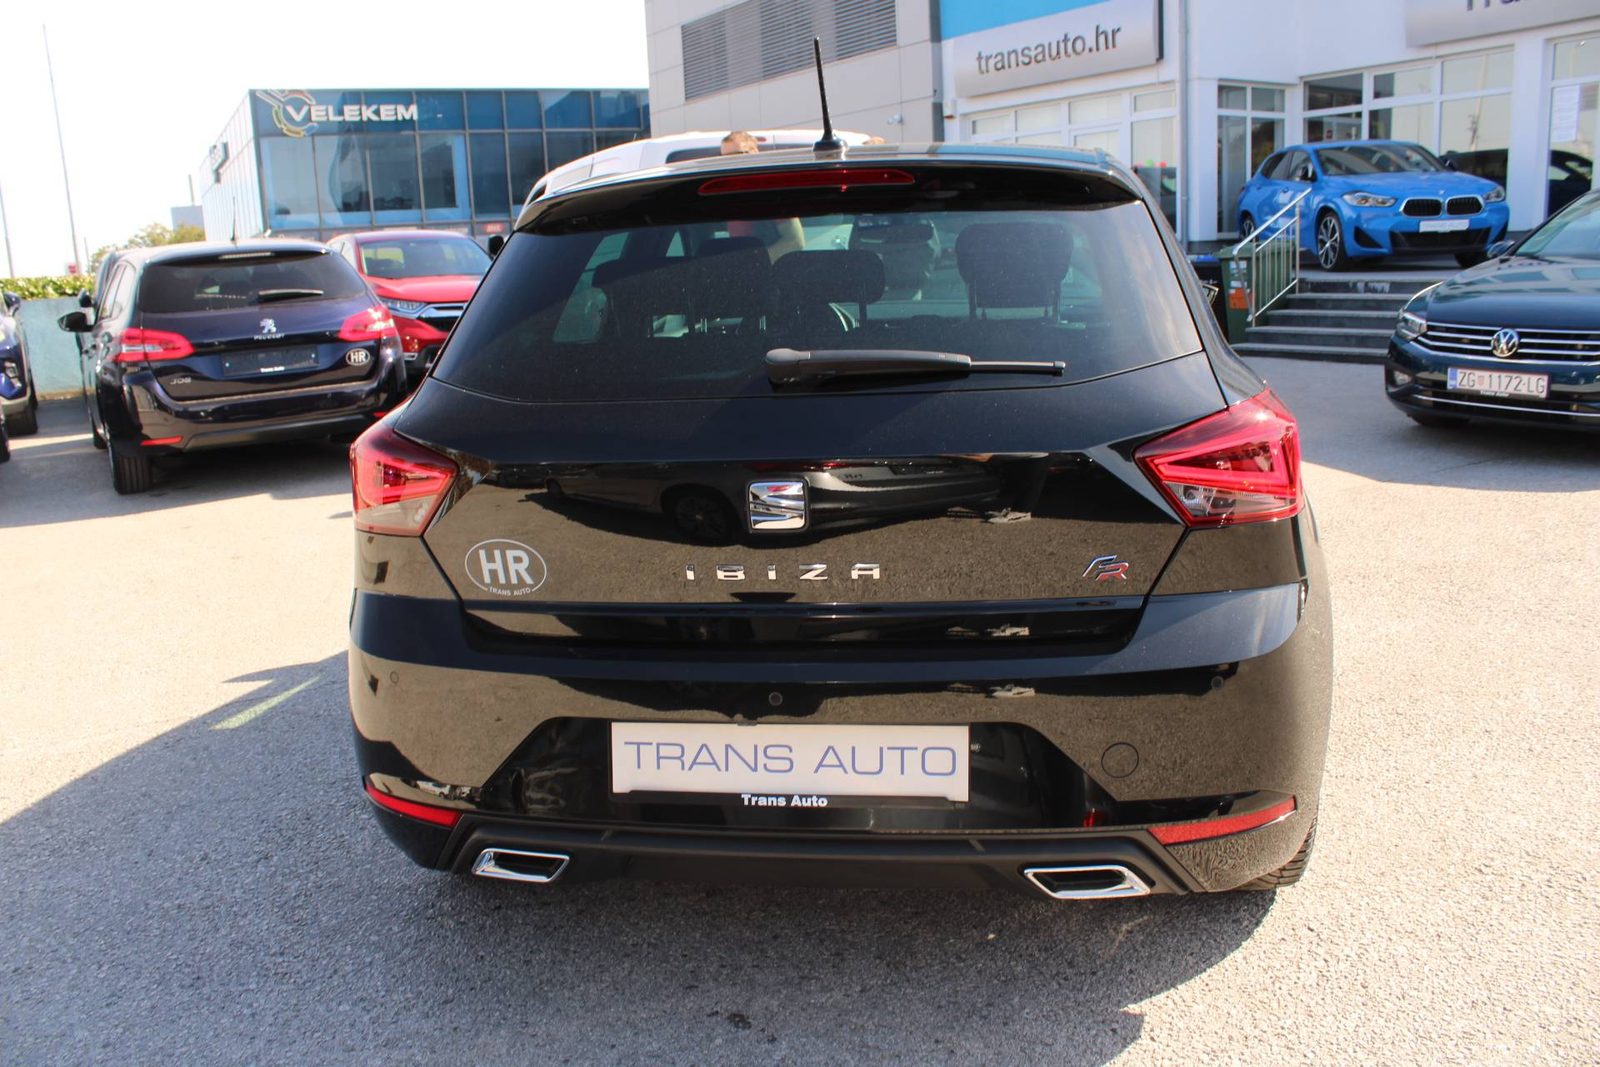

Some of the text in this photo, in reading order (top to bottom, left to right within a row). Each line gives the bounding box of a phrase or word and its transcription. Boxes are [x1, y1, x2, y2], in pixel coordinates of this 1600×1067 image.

[976, 24, 1122, 75] transauto.hr
[286, 104, 418, 122] VELEKEM
[350, 350, 367, 363] HR
[1458, 371, 1476, 388] ZG
[478, 548, 535, 585] HR
[685, 563, 881, 581] IBIZA
[489, 585, 531, 597] TRANS AUTO
[623, 741, 957, 777] TRANS AUTO
[741, 793, 828, 808] Trans Auto
